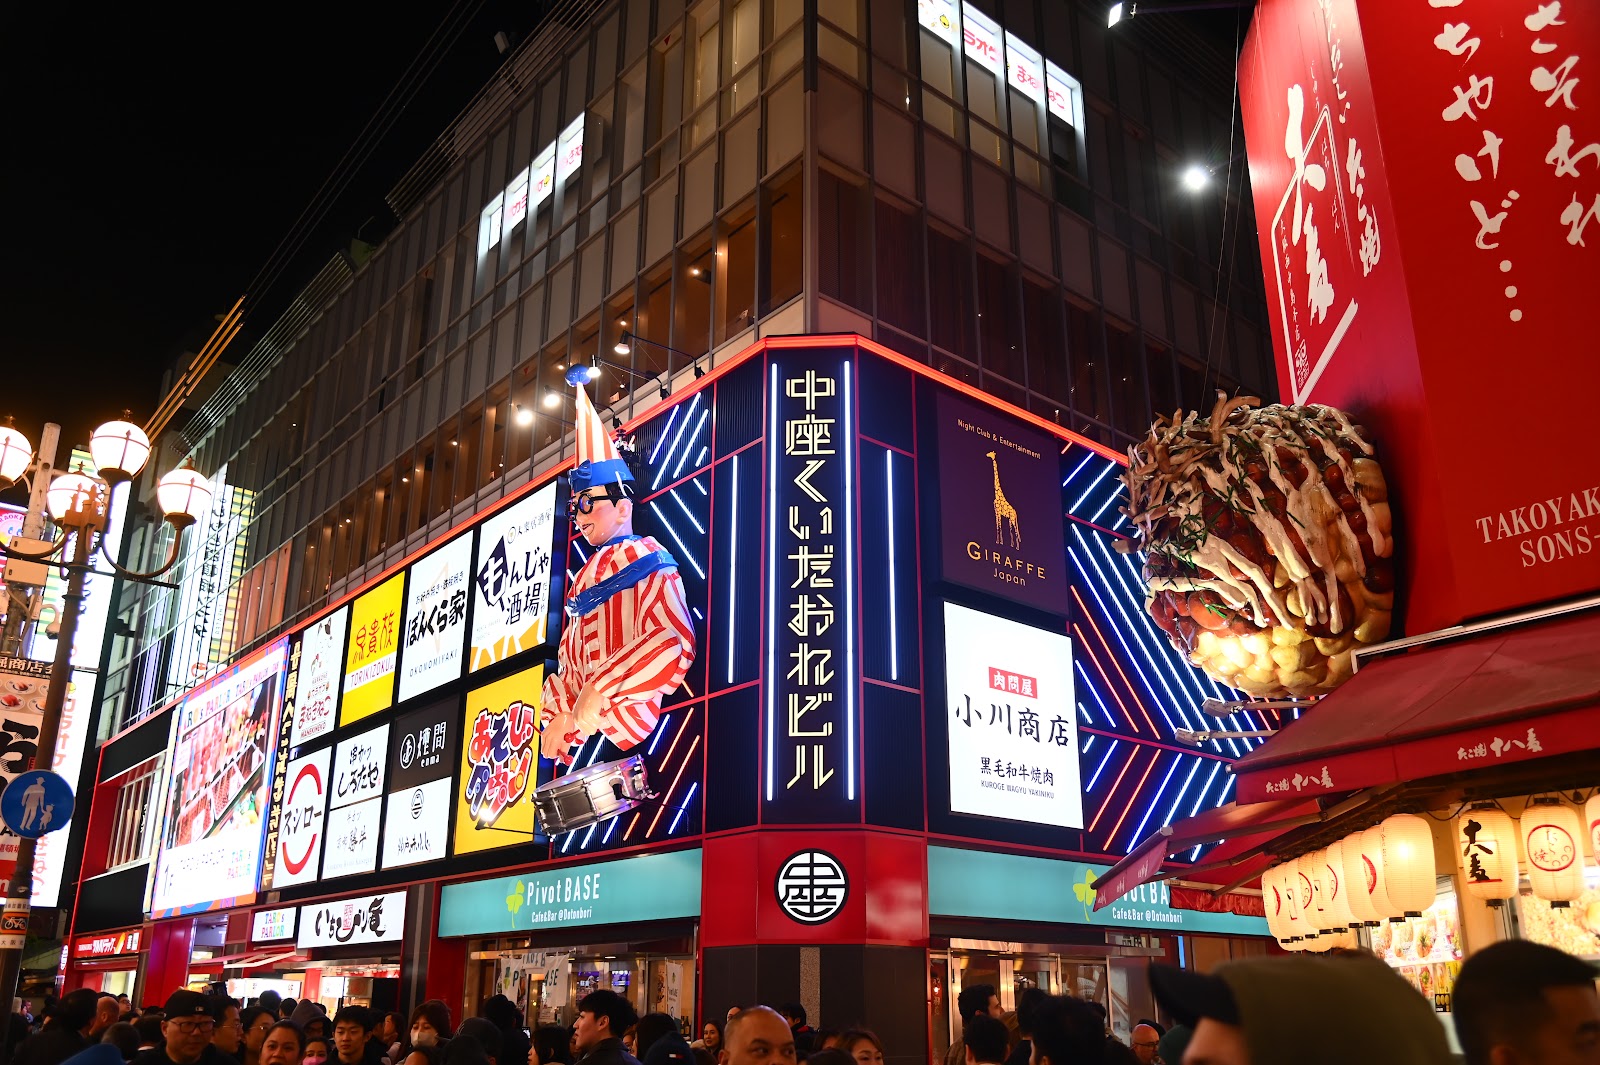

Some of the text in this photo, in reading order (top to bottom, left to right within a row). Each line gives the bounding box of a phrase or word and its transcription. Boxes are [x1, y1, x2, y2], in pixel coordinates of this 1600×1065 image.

[957, 419, 1041, 459] Night Club & Entertainment
[967, 541, 1046, 579] GIRAFFE
[483, 546, 550, 609] もんじゃ
[786, 370, 836, 790] 中座くいだおれビル
[994, 567, 1026, 586] Japan
[405, 589, 466, 649] ぼんくら家
[506, 582, 541, 625] 酒場
[350, 657, 390, 688] TORIKIZOKU
[409, 649, 458, 678] OKONOMIYAKI
[993, 671, 1033, 696] 肉問屋
[468, 700, 535, 764] あそび
[955, 693, 1070, 747] 小川商店
[420, 754, 440, 768] enma
[980, 756, 1054, 787] 黒毛和牛焼肉
[981, 780, 1055, 799] KUROGE WAGYU YAKINIKU
[281, 805, 323, 837] スシロー
[265, 912, 285, 926] TARO's
[531, 909, 558, 923] Cafe&Bar
[1112, 907, 1183, 924] Cafe&Bar @Dotonbori
[261, 925, 285, 938] PARLOR
